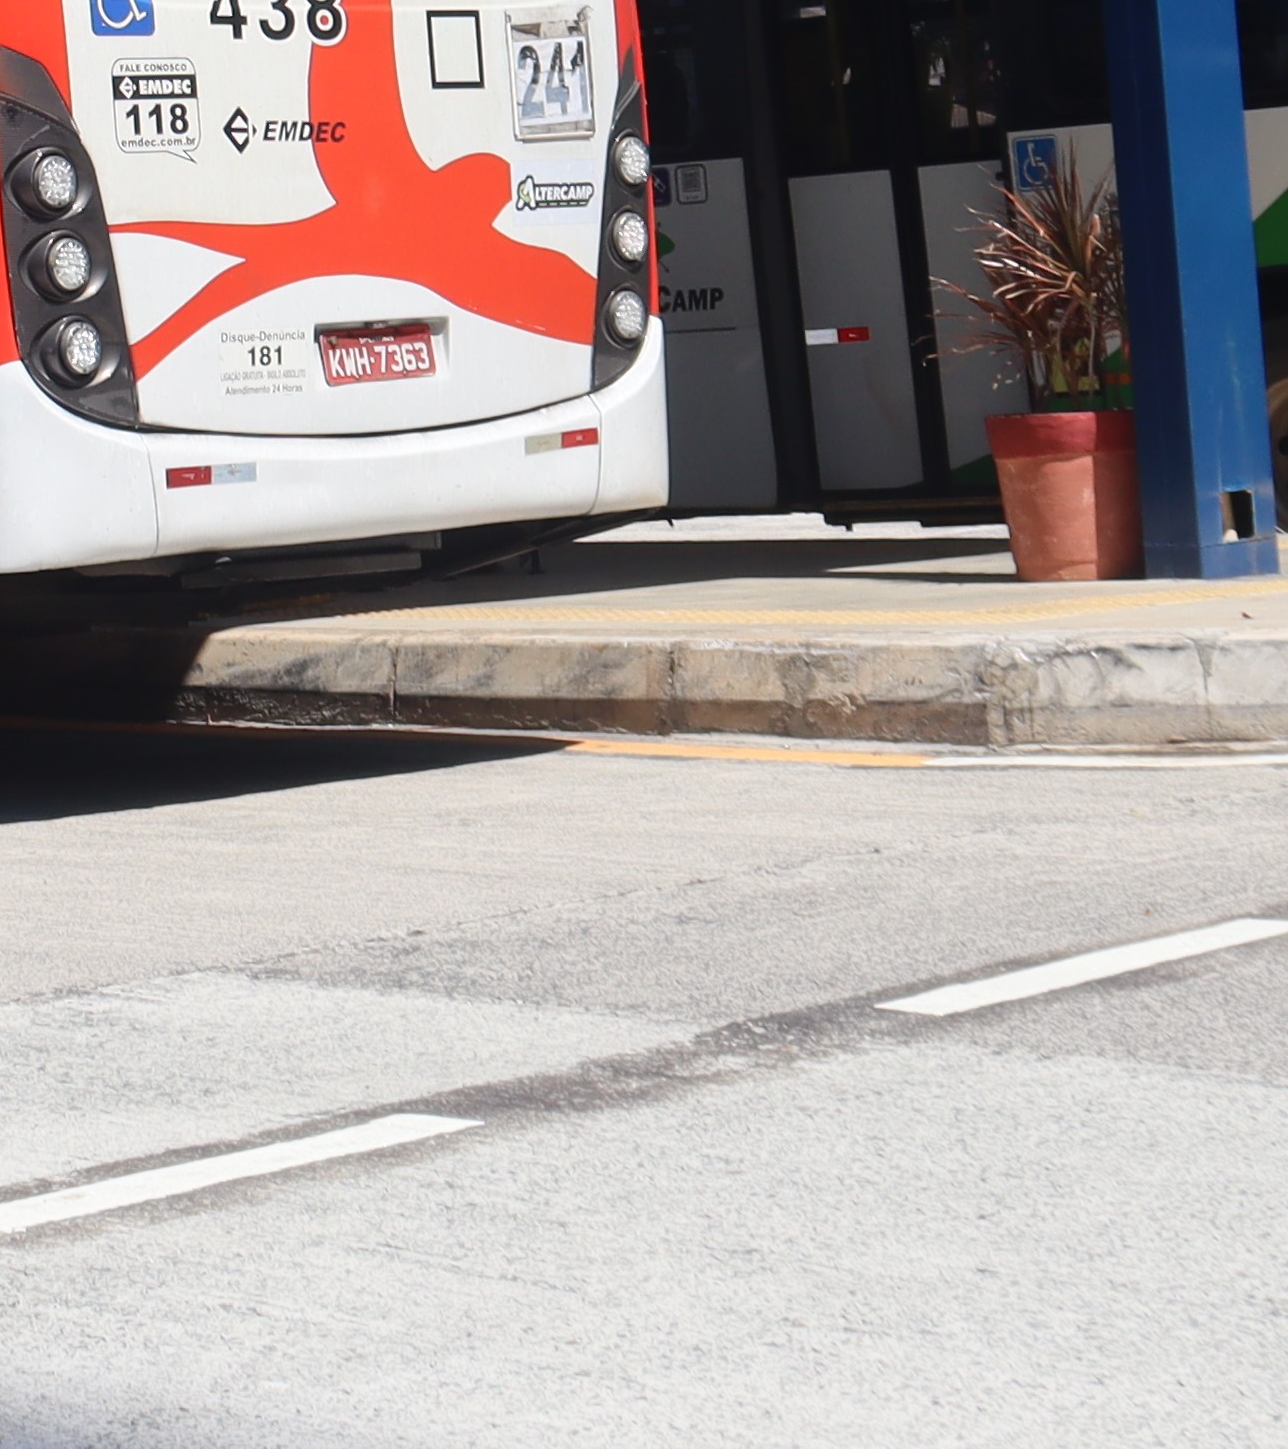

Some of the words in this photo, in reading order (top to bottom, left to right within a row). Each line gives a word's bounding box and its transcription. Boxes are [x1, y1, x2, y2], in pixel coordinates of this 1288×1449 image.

[120, 63, 141, 73] FALE
[144, 62, 187, 72] CONOSCO
[139, 79, 192, 95] EMDEC
[125, 102, 190, 136] 118
[262, 120, 346, 143] EMDEC
[121, 136, 196, 148] emdec.com.br
[516, 176, 594, 210] ALTERCAMP
[221, 330, 305, 345] Disque-Denúncia
[247, 345, 283, 366] 181
